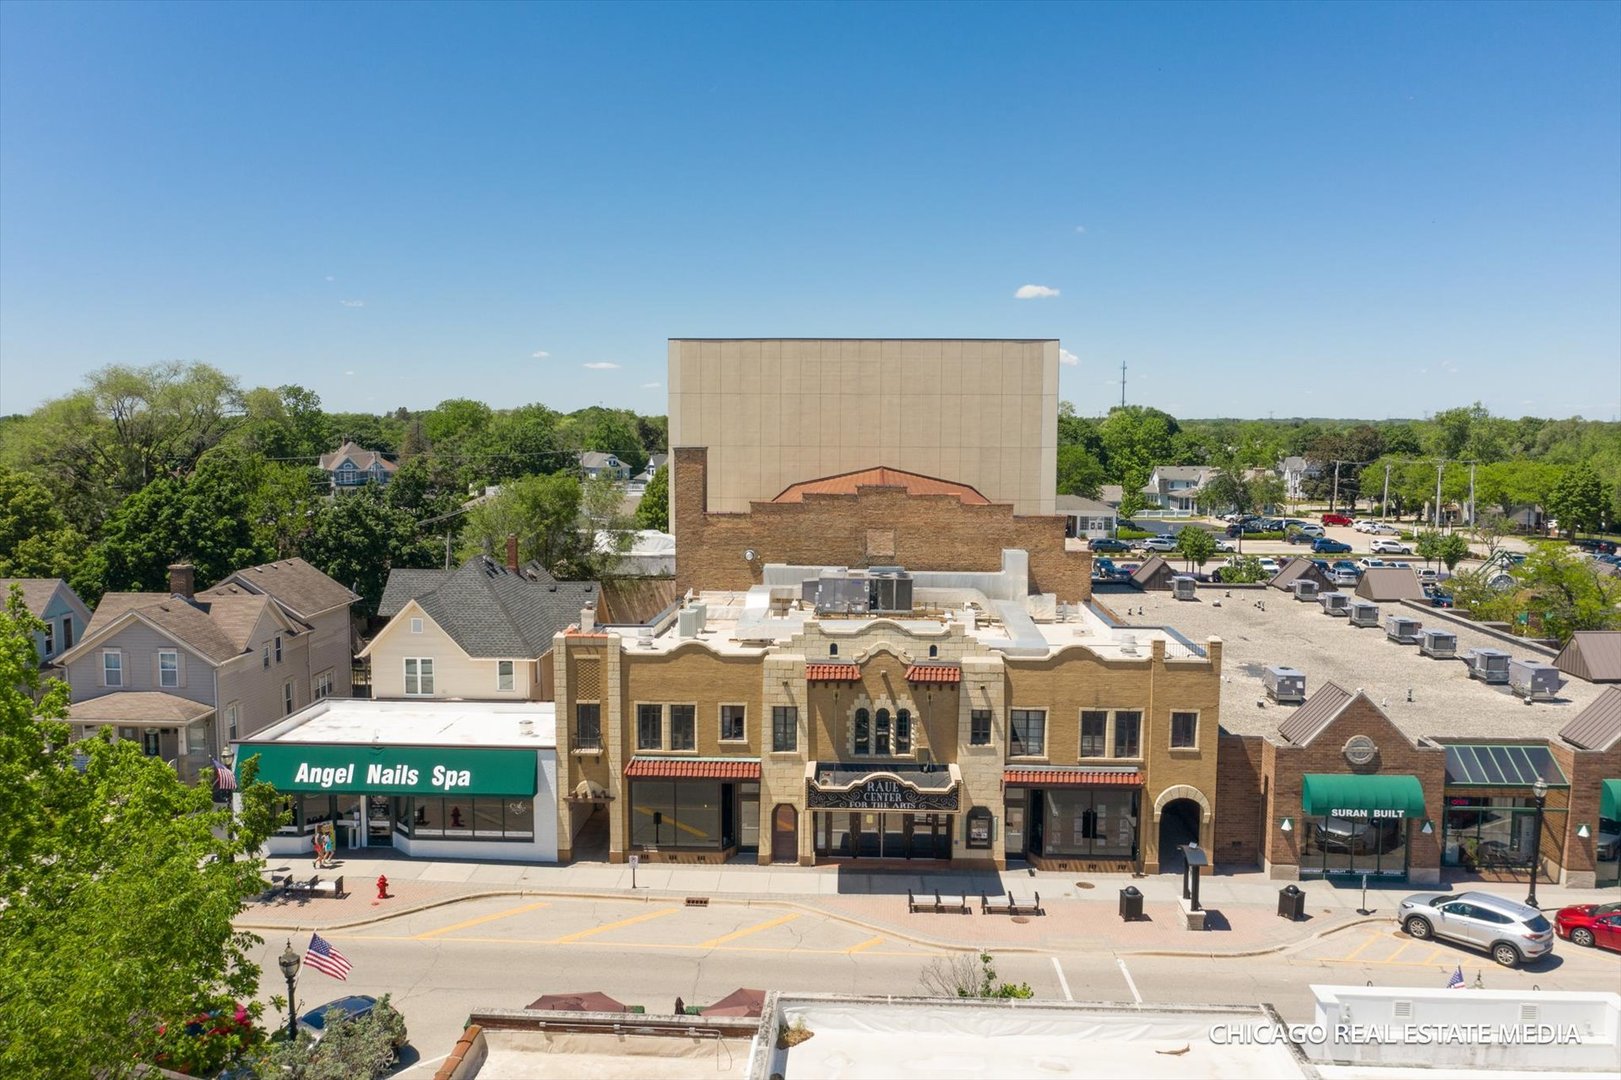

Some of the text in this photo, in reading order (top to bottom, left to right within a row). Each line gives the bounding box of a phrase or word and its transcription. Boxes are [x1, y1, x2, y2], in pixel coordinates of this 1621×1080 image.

[295, 763, 471, 790] Angel Nails Spa
[867, 781, 899, 791] RAUE
[863, 792, 902, 801] CENTER
[1331, 808, 1405, 818] SURAN BUILT
